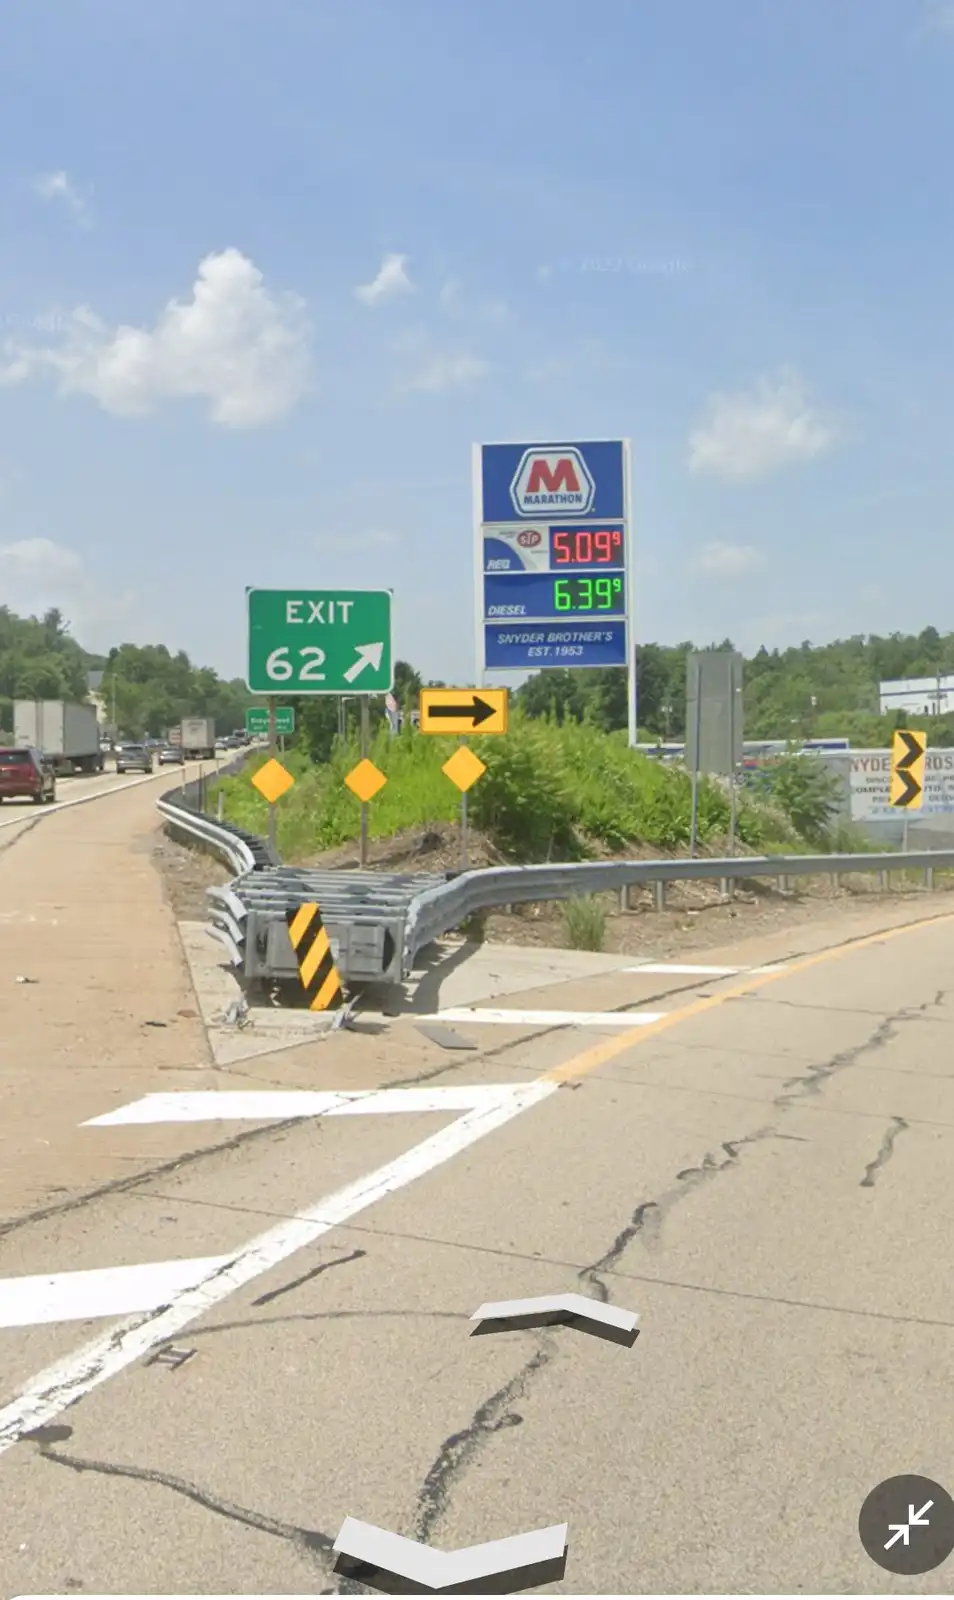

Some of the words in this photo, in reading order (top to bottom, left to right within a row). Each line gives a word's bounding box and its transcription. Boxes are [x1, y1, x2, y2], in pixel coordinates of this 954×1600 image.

[526, 459, 580, 493] M
[523, 494, 583, 505] MARATHON
[520, 531, 538, 545] STP
[286, 600, 355, 624] EXIT
[488, 605, 527, 616] DIESEL
[497, 633, 545, 645] SNYDER
[547, 631, 613, 643] BROTHER'S
[266, 646, 326, 681] 62
[850, 758, 890, 773] NYDE
